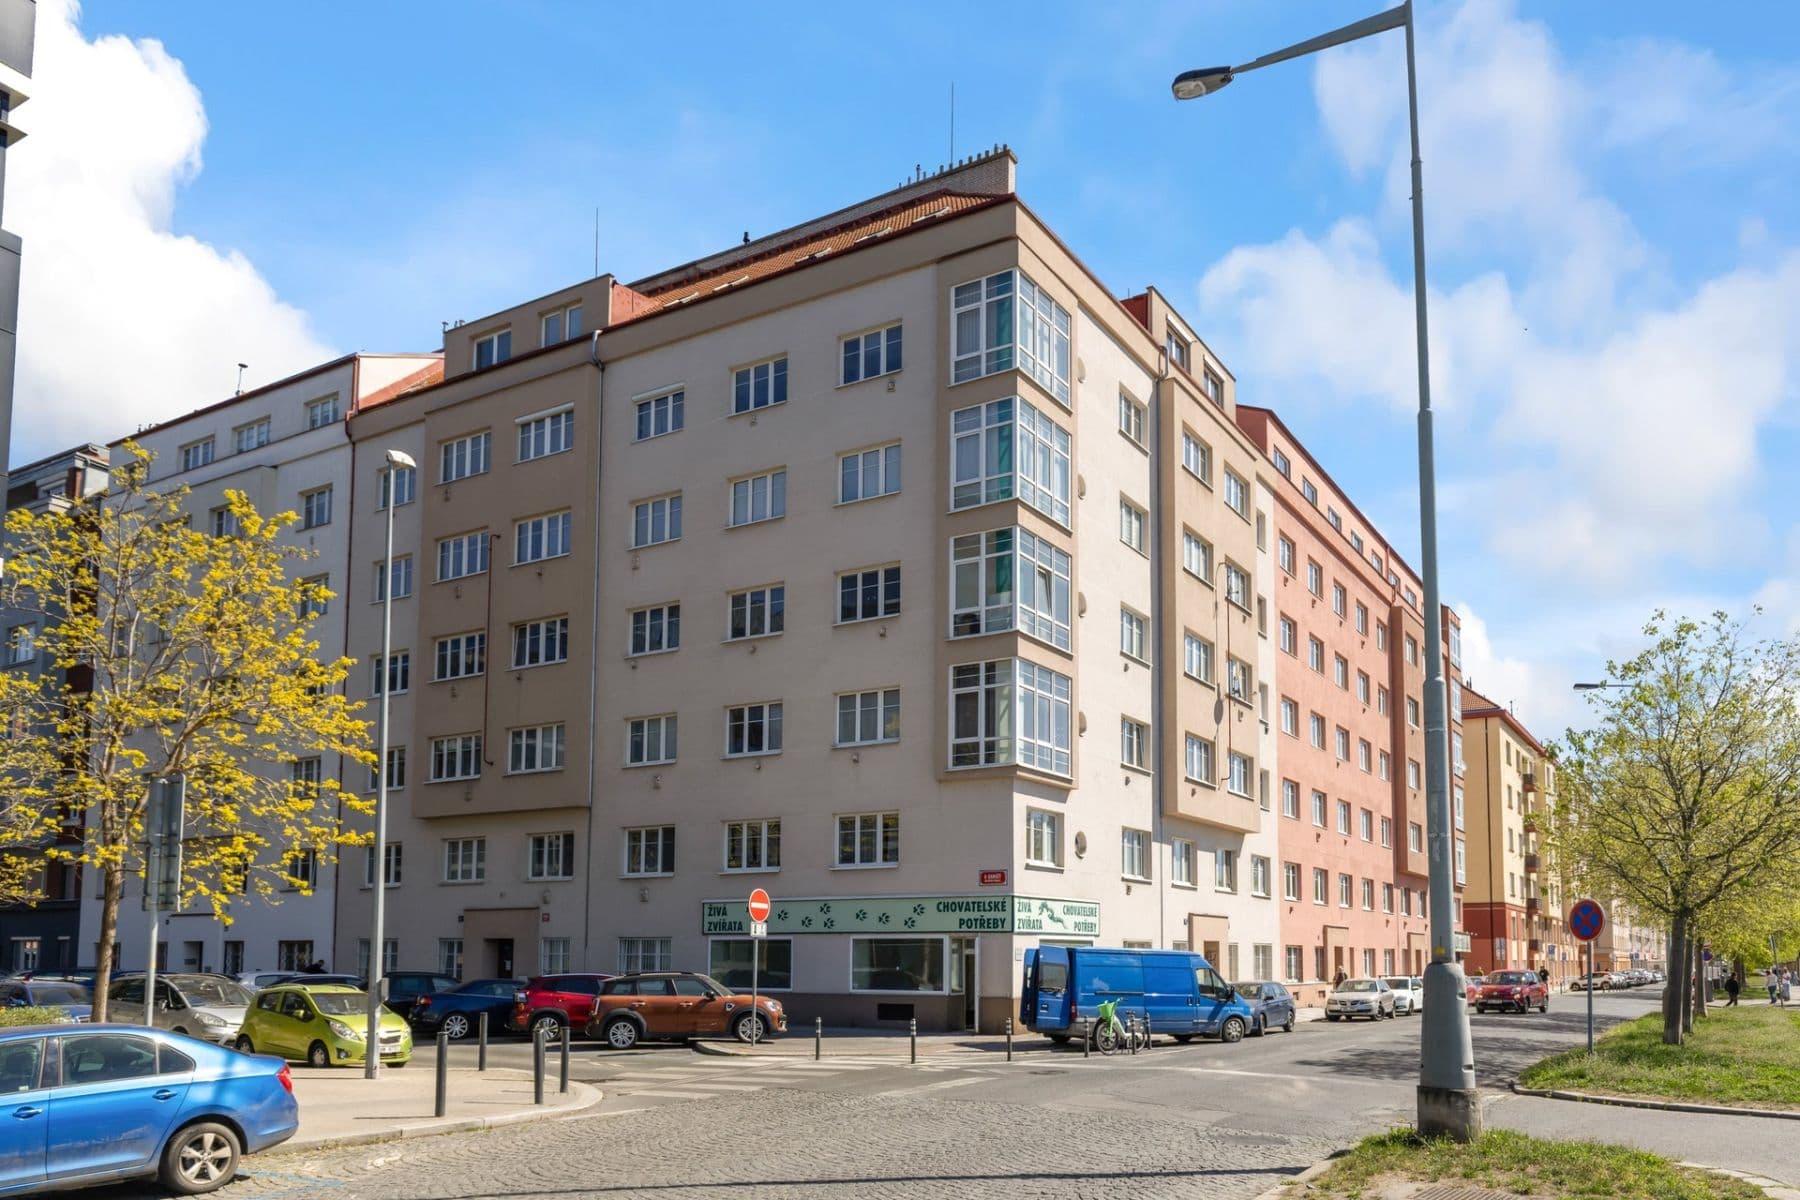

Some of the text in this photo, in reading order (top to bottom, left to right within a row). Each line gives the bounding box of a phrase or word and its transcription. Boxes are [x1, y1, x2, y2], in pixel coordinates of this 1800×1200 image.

[708, 904, 727, 917] ŽIVÁ
[936, 898, 1007, 912] CHOVATELSKÉ
[708, 919, 743, 931] ZVÍŘATA
[959, 915, 1006, 929] POTŘEBY
